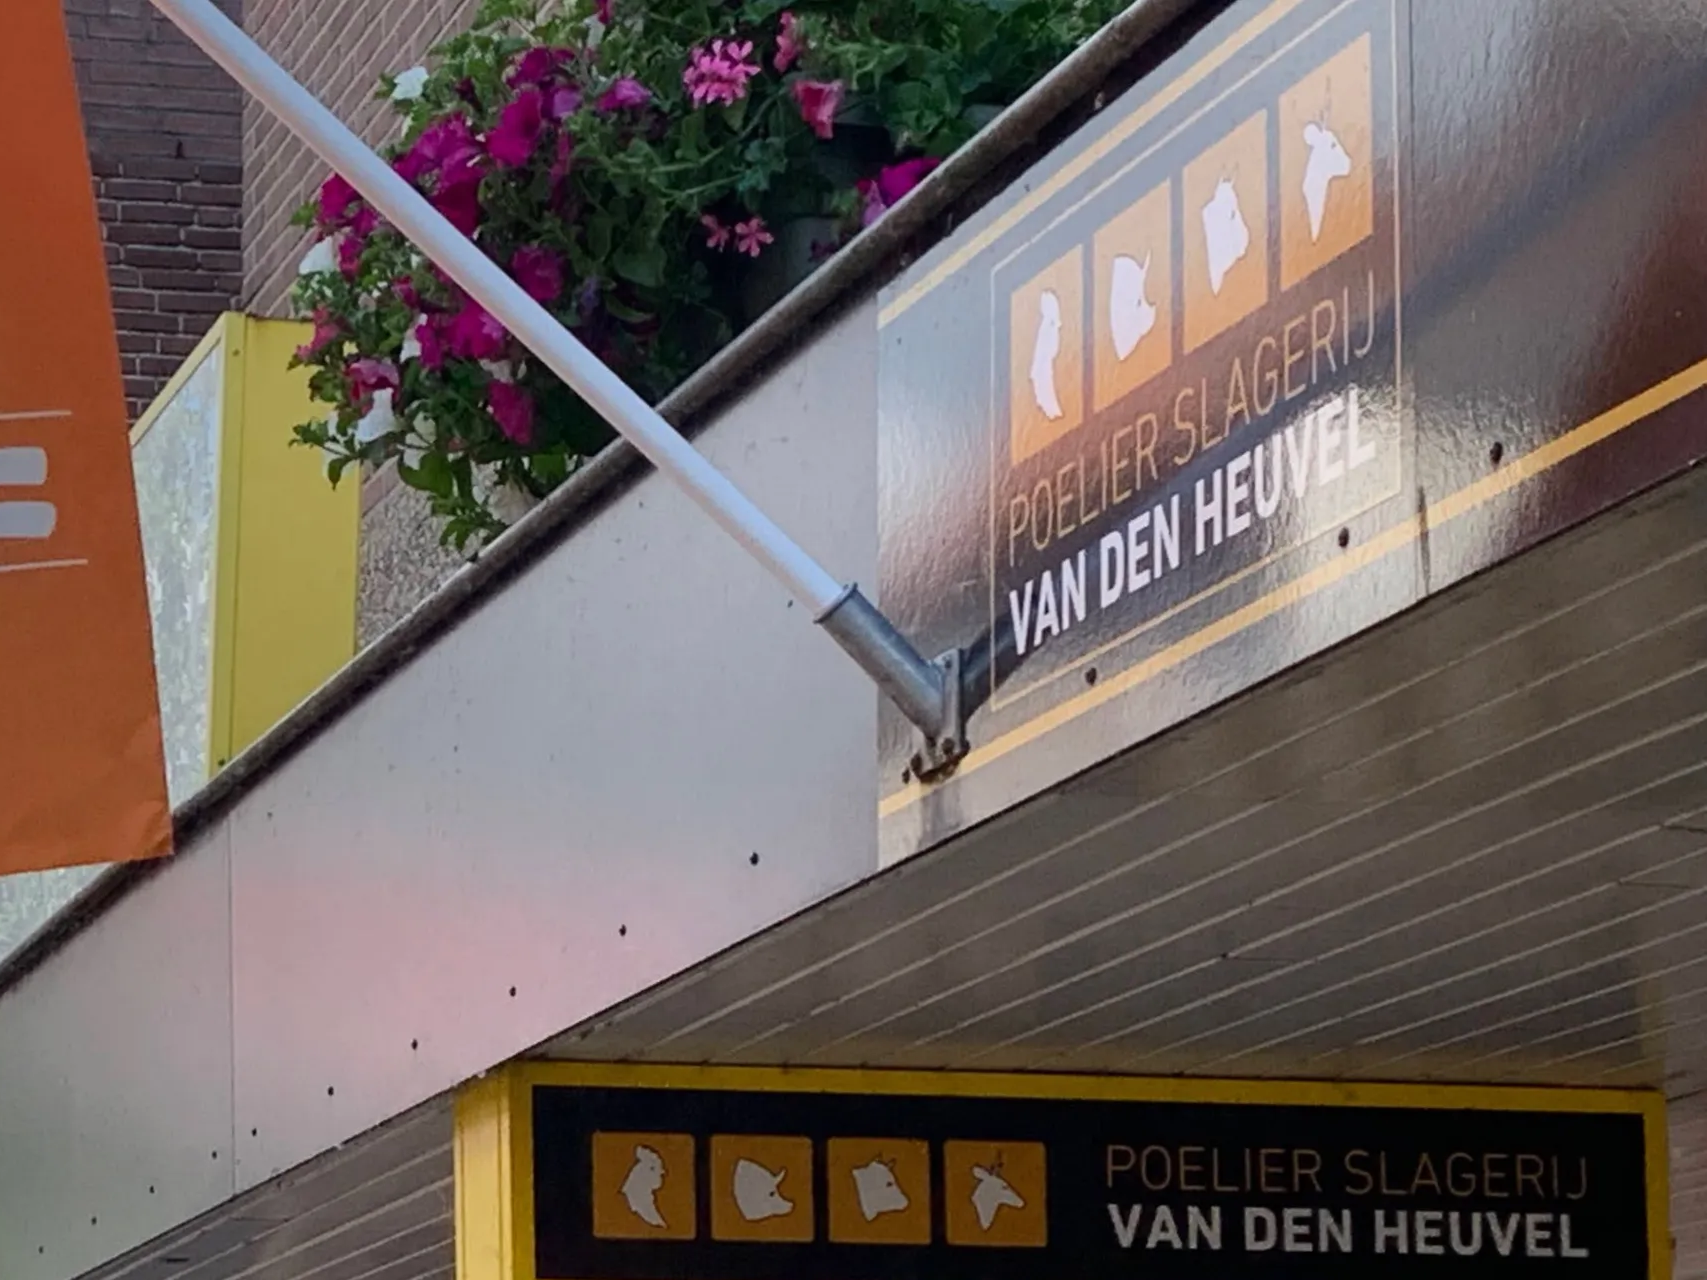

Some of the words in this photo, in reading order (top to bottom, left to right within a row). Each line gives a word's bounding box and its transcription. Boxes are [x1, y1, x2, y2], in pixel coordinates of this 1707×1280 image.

[1007, 411, 1160, 568] POELIER
[1173, 269, 1375, 467] SLAGERIJ
[1008, 549, 1087, 656] VAN
[1098, 493, 1180, 608] DEN
[1194, 388, 1376, 555] HEUVEL
[1105, 1144, 1323, 1194] POELIER
[1344, 1149, 1589, 1200] SLAGERIJ
[1106, 1203, 1222, 1251] VAN
[1243, 1206, 1353, 1254] DEN
[1373, 1210, 1590, 1258] HEUVEL
